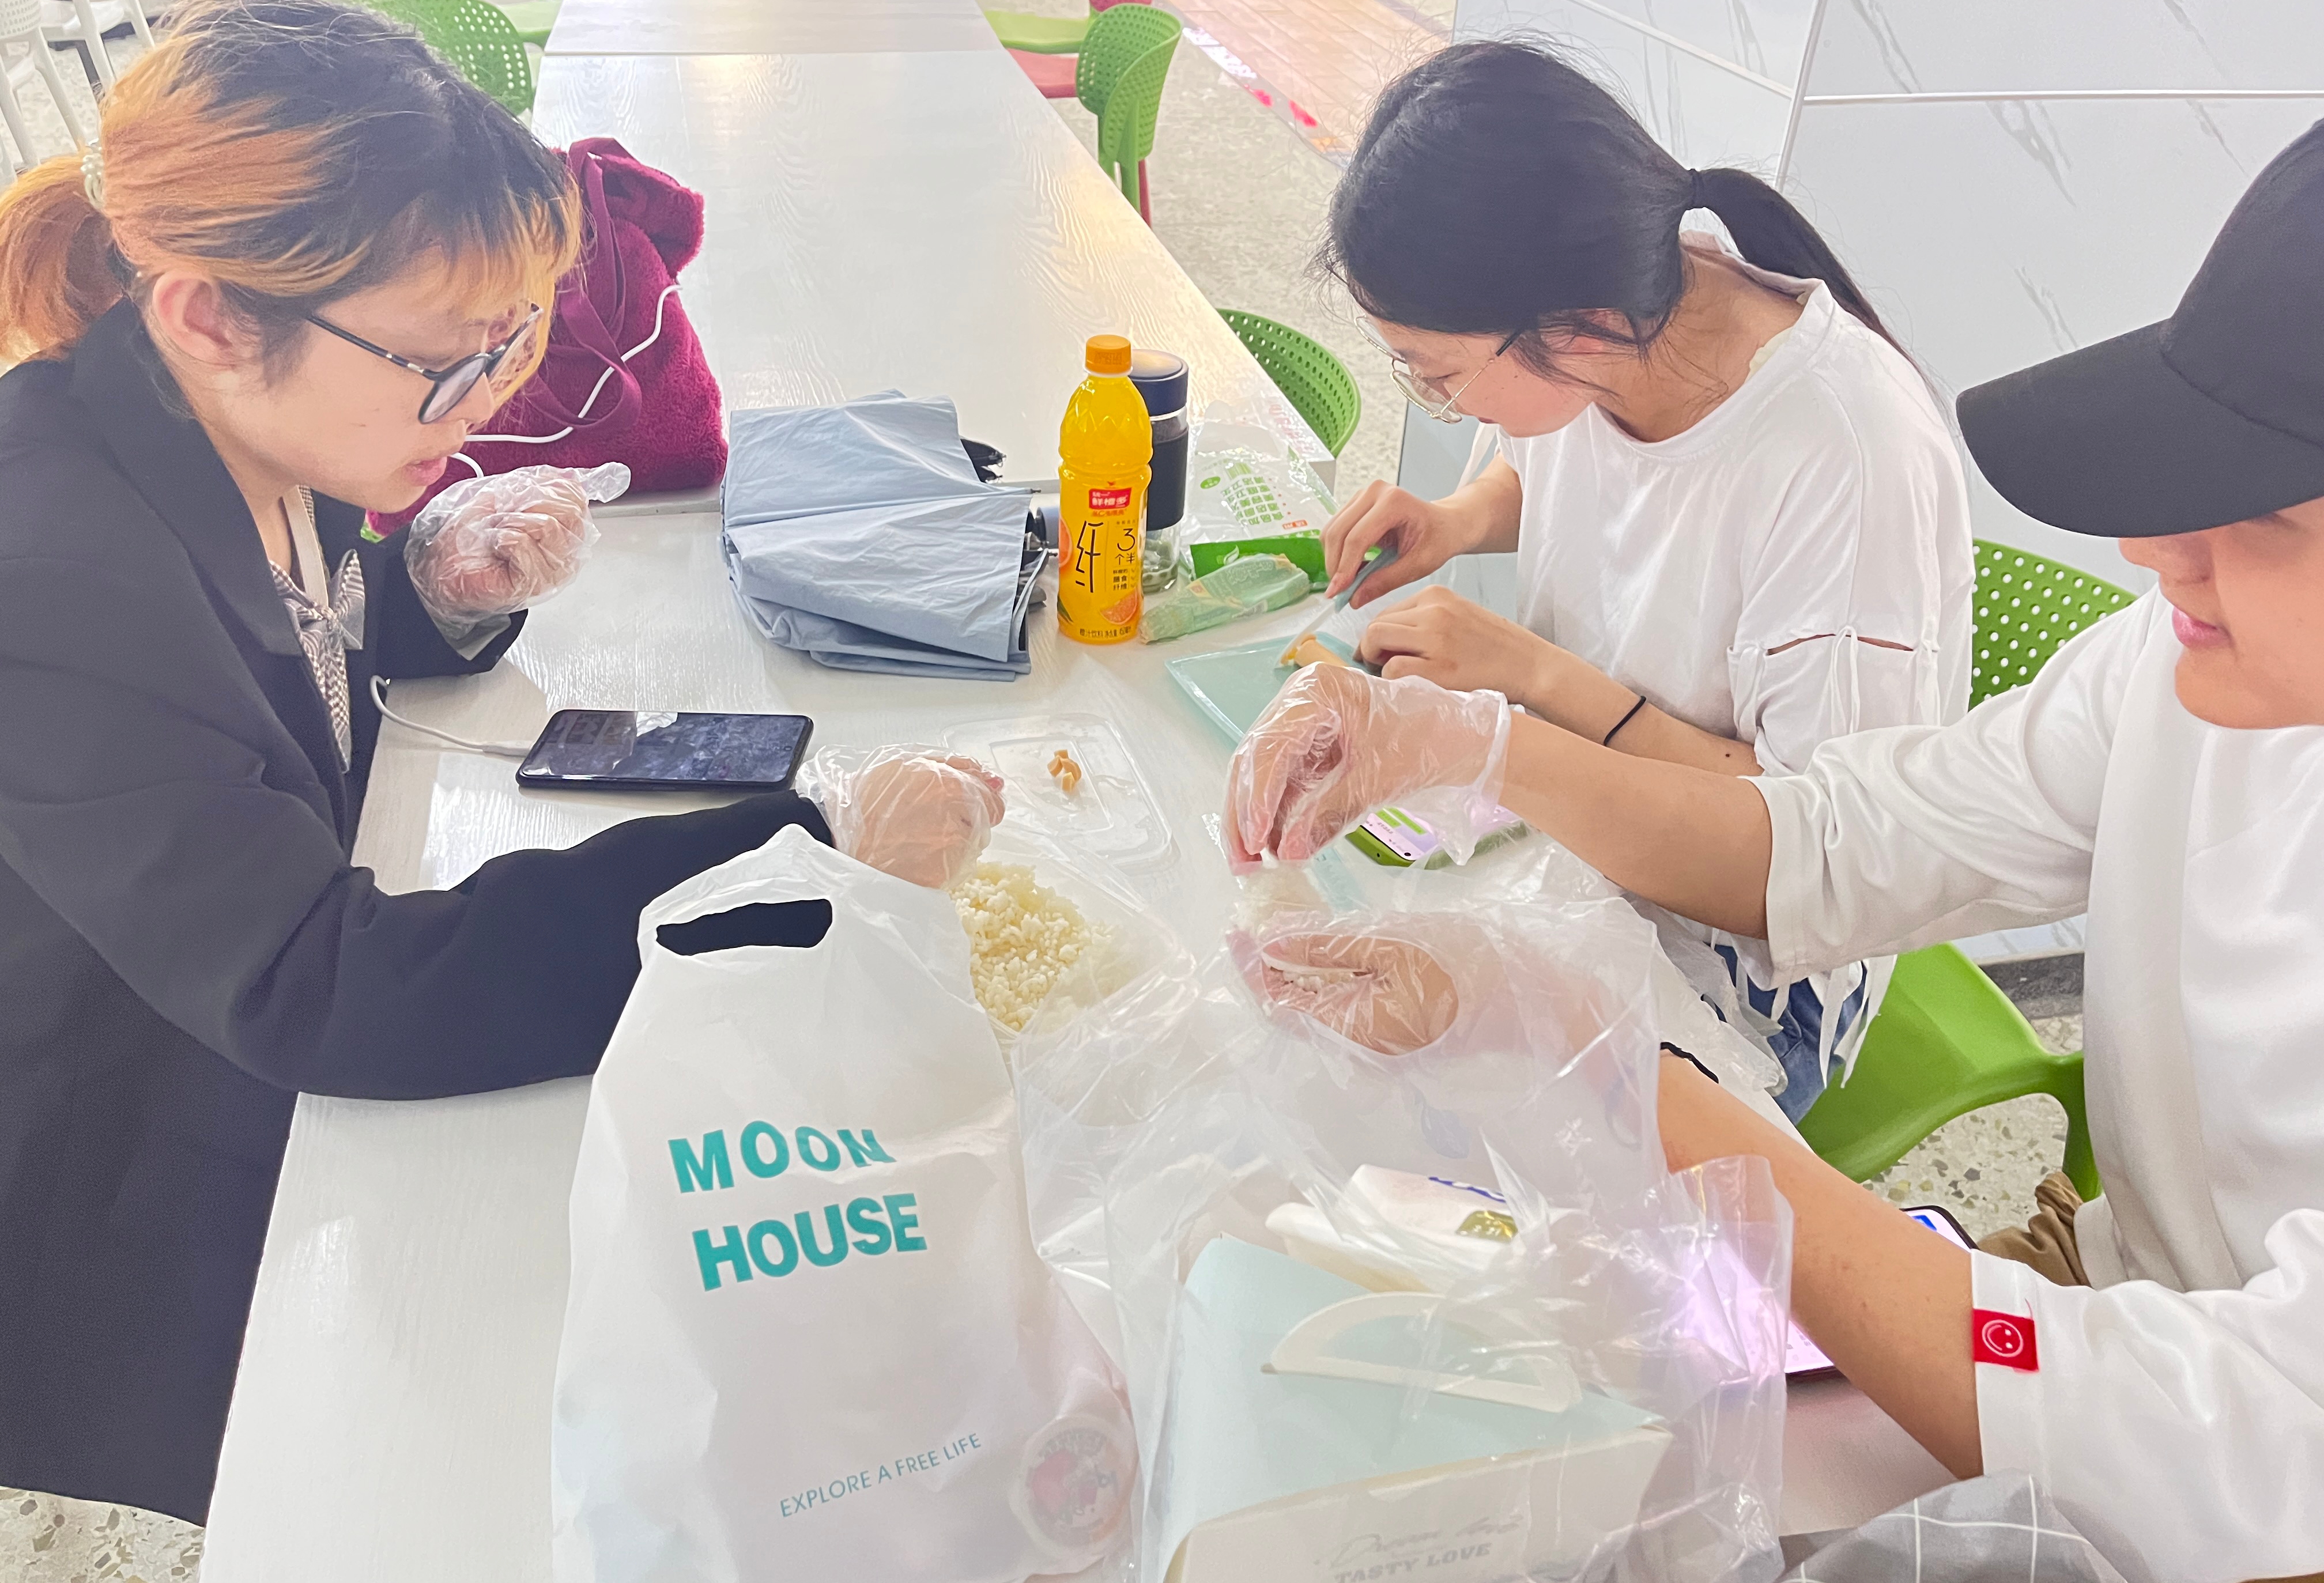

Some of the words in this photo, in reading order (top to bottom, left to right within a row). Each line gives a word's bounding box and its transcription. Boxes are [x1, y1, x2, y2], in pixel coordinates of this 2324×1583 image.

[668, 1120, 897, 1193] MOON
[692, 1193, 927, 1291] HOUSE
[780, 1470, 872, 1517] EXPLORE
[878, 1465, 892, 1484] A
[895, 1450, 940, 1476] FREE
[943, 1433, 982, 1460] LIFE
[1427, 1542, 1493, 1567] LOVE
